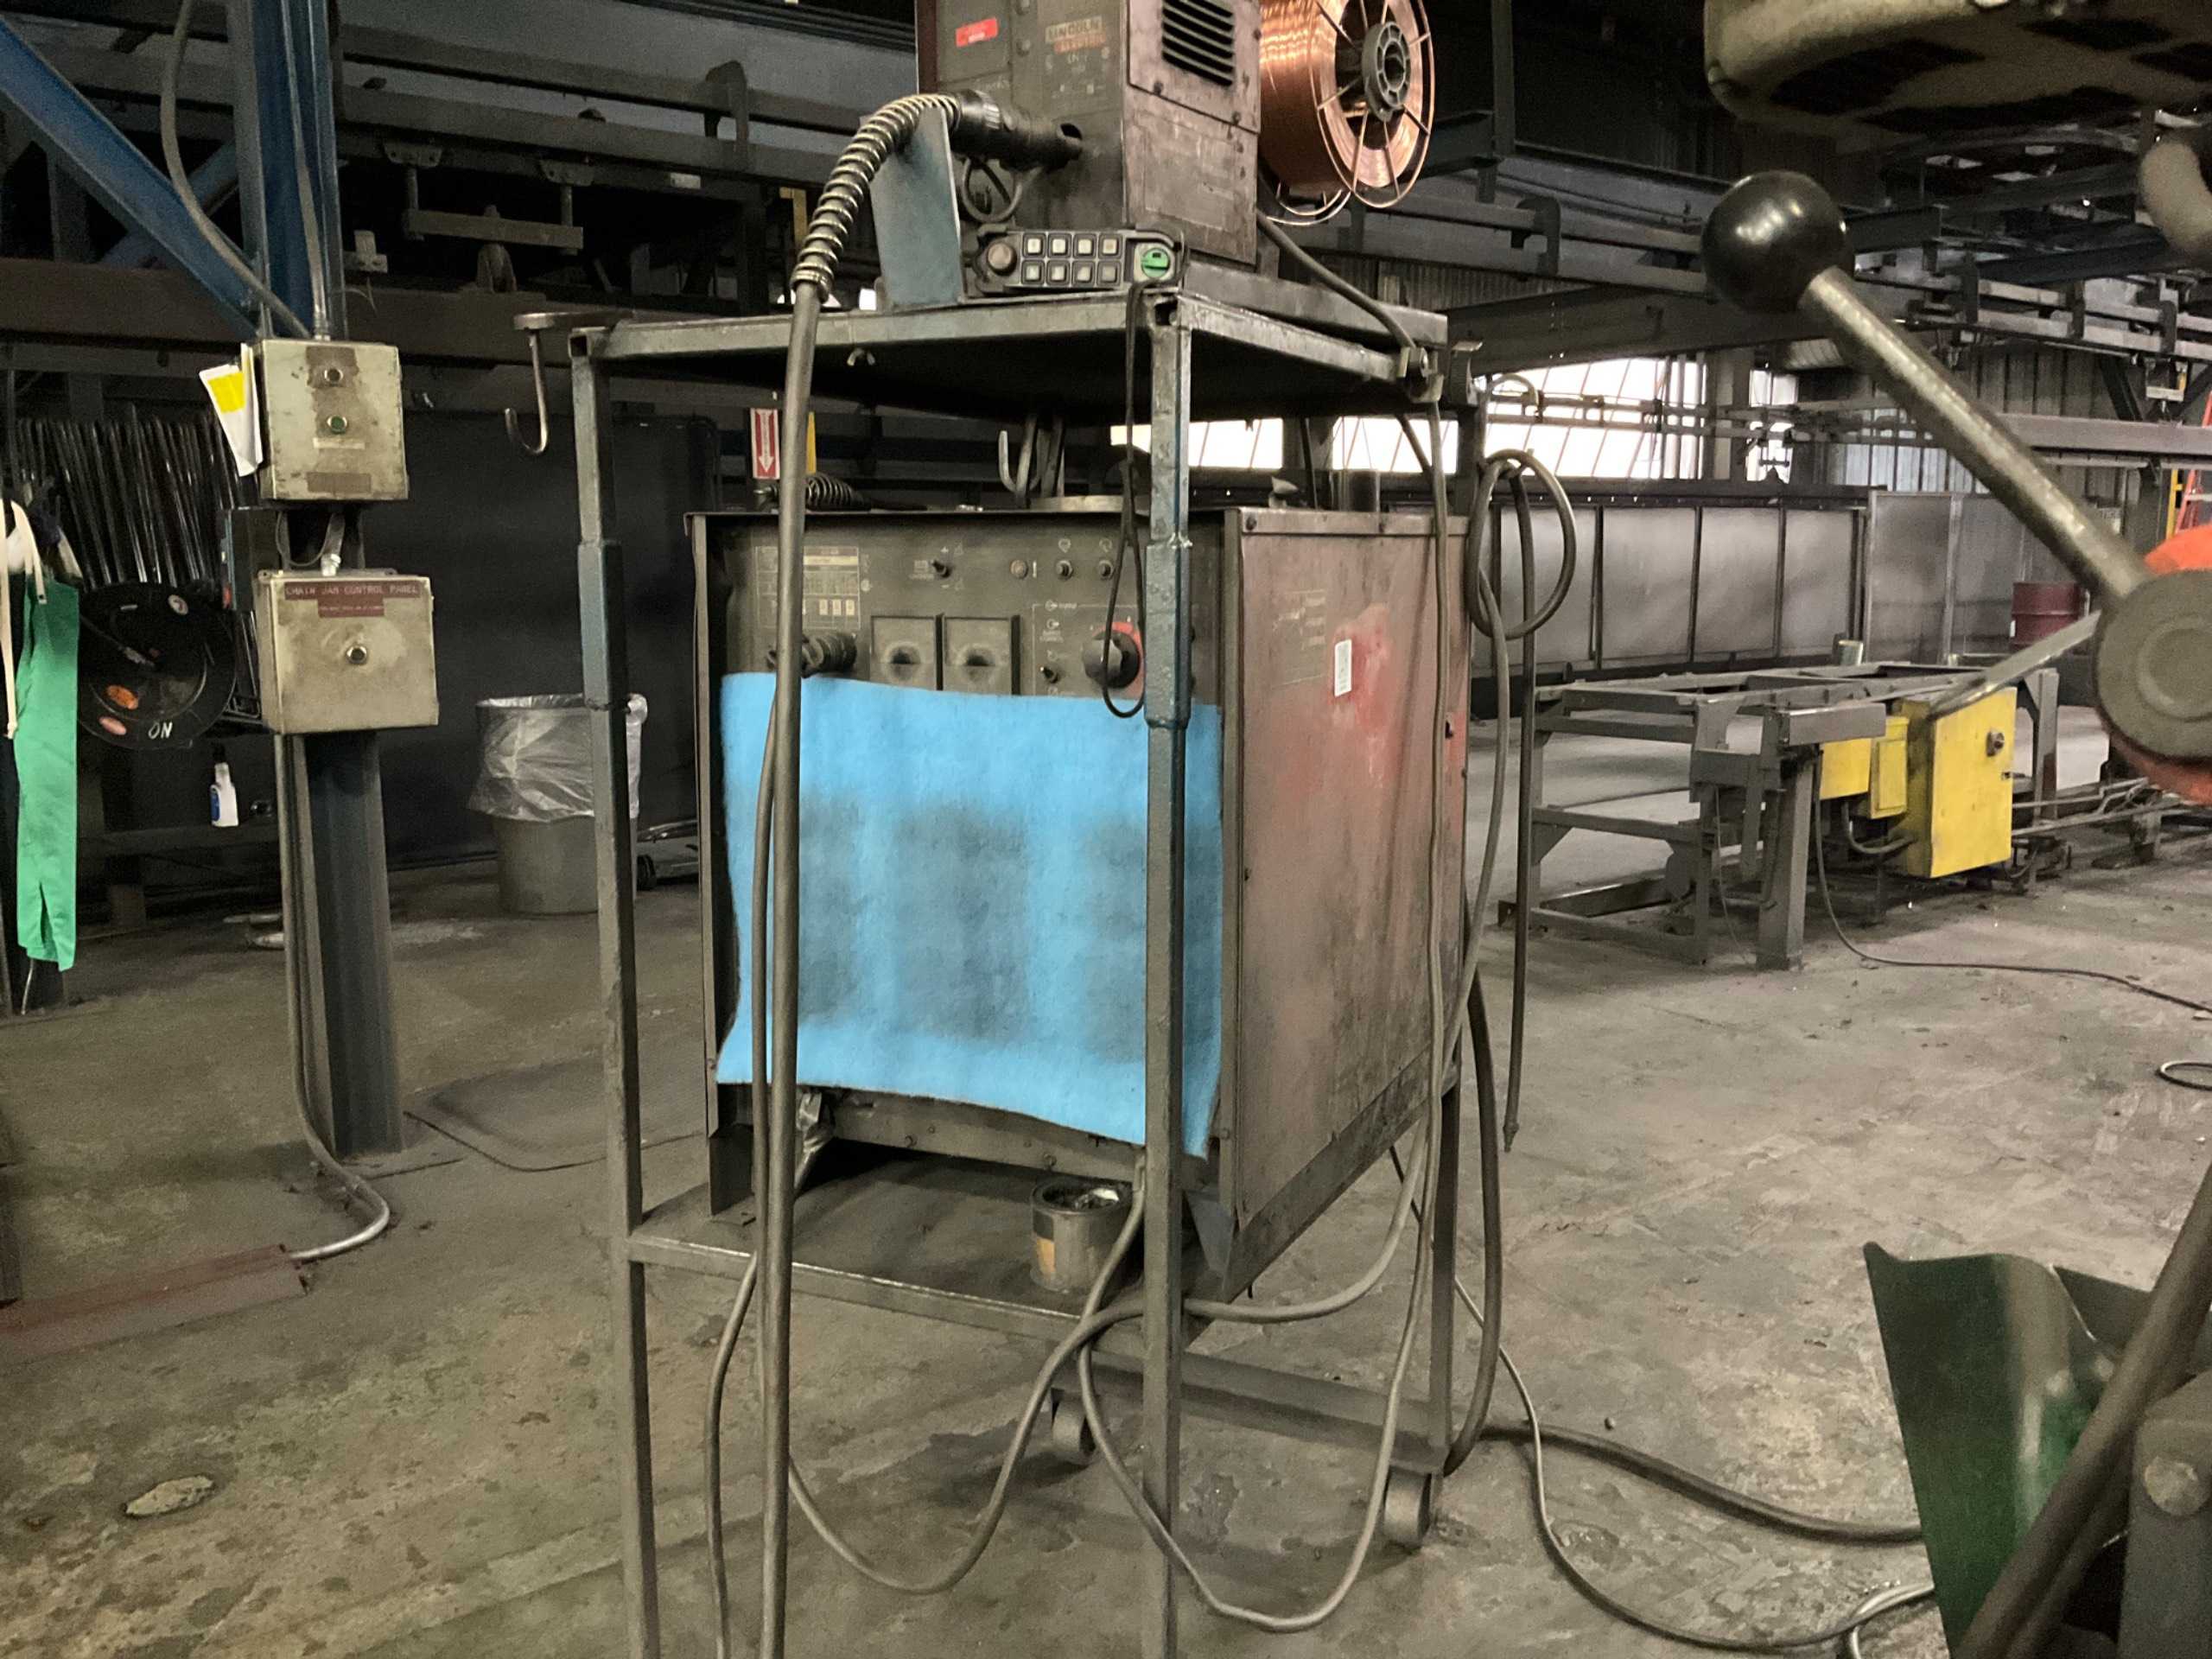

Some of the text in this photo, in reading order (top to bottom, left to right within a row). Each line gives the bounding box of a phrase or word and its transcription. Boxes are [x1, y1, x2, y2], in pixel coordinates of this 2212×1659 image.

[286, 587, 316, 595] CHAIN
[344, 586, 385, 595] CONTROL
[389, 585, 418, 594] PANEL
[148, 721, 174, 741] ON
